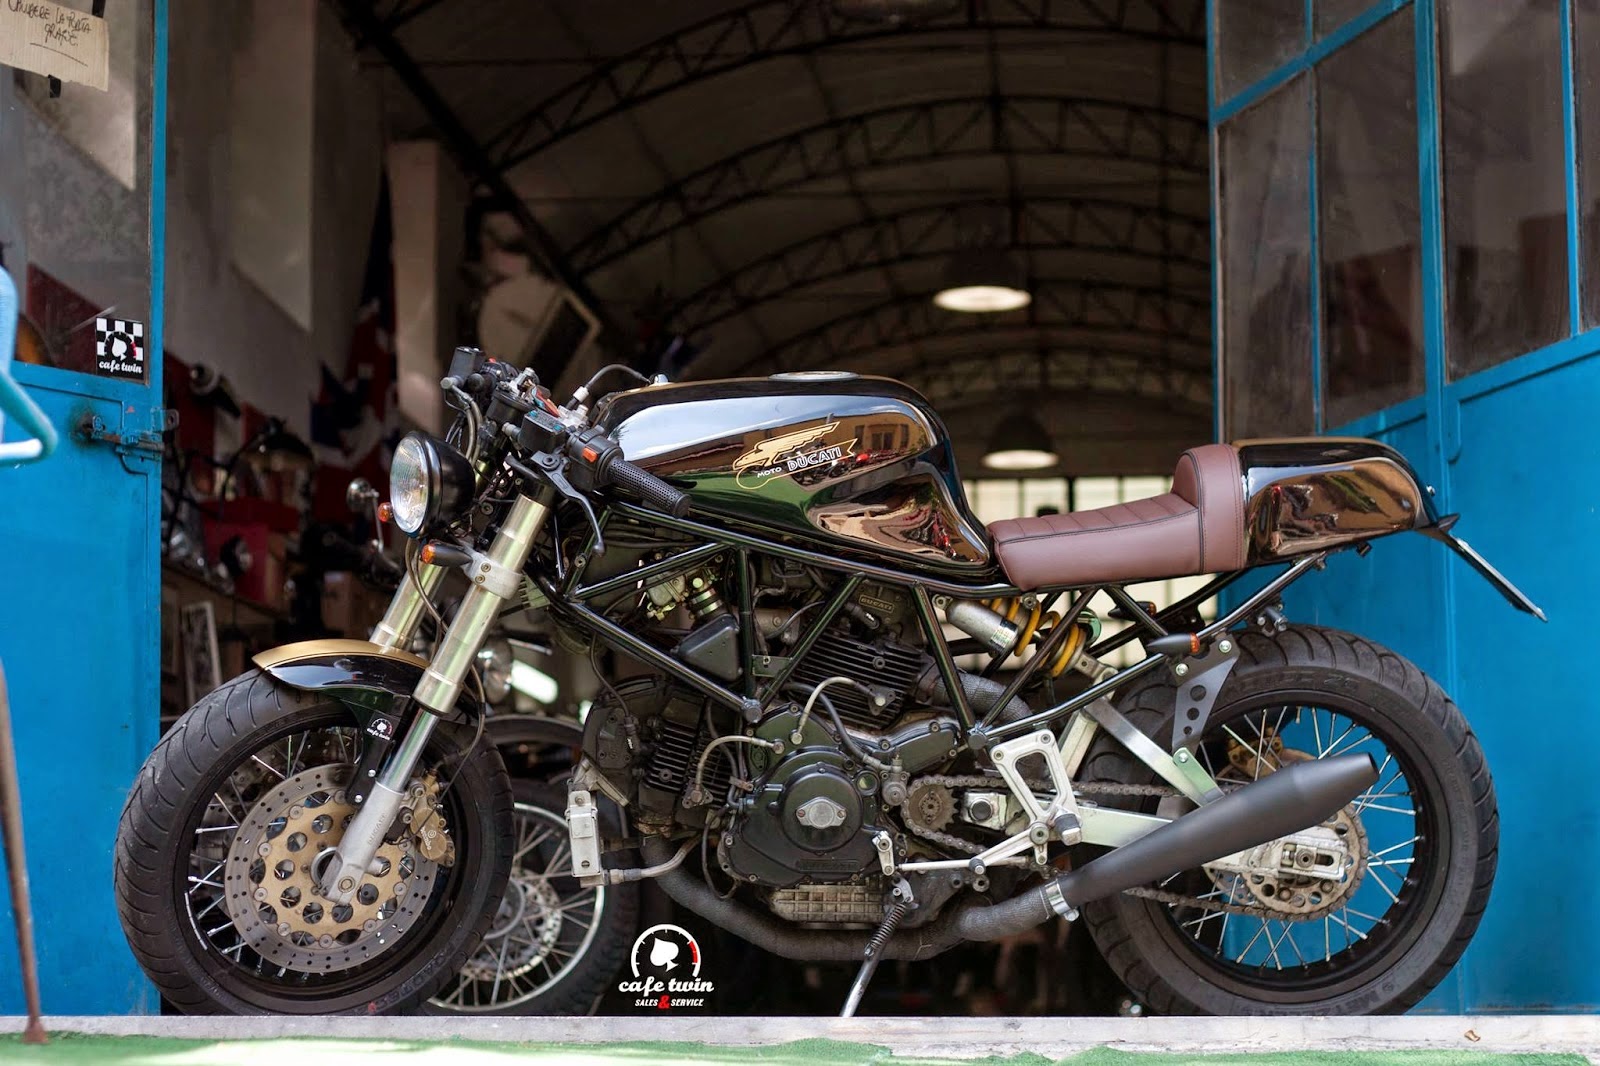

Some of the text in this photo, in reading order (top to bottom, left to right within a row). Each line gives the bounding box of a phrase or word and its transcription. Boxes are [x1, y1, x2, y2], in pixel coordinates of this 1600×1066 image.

[98, 359, 143, 374] cafe twin
[757, 446, 842, 478] MOTO DUCATI
[860, 597, 892, 611] DUCATI
